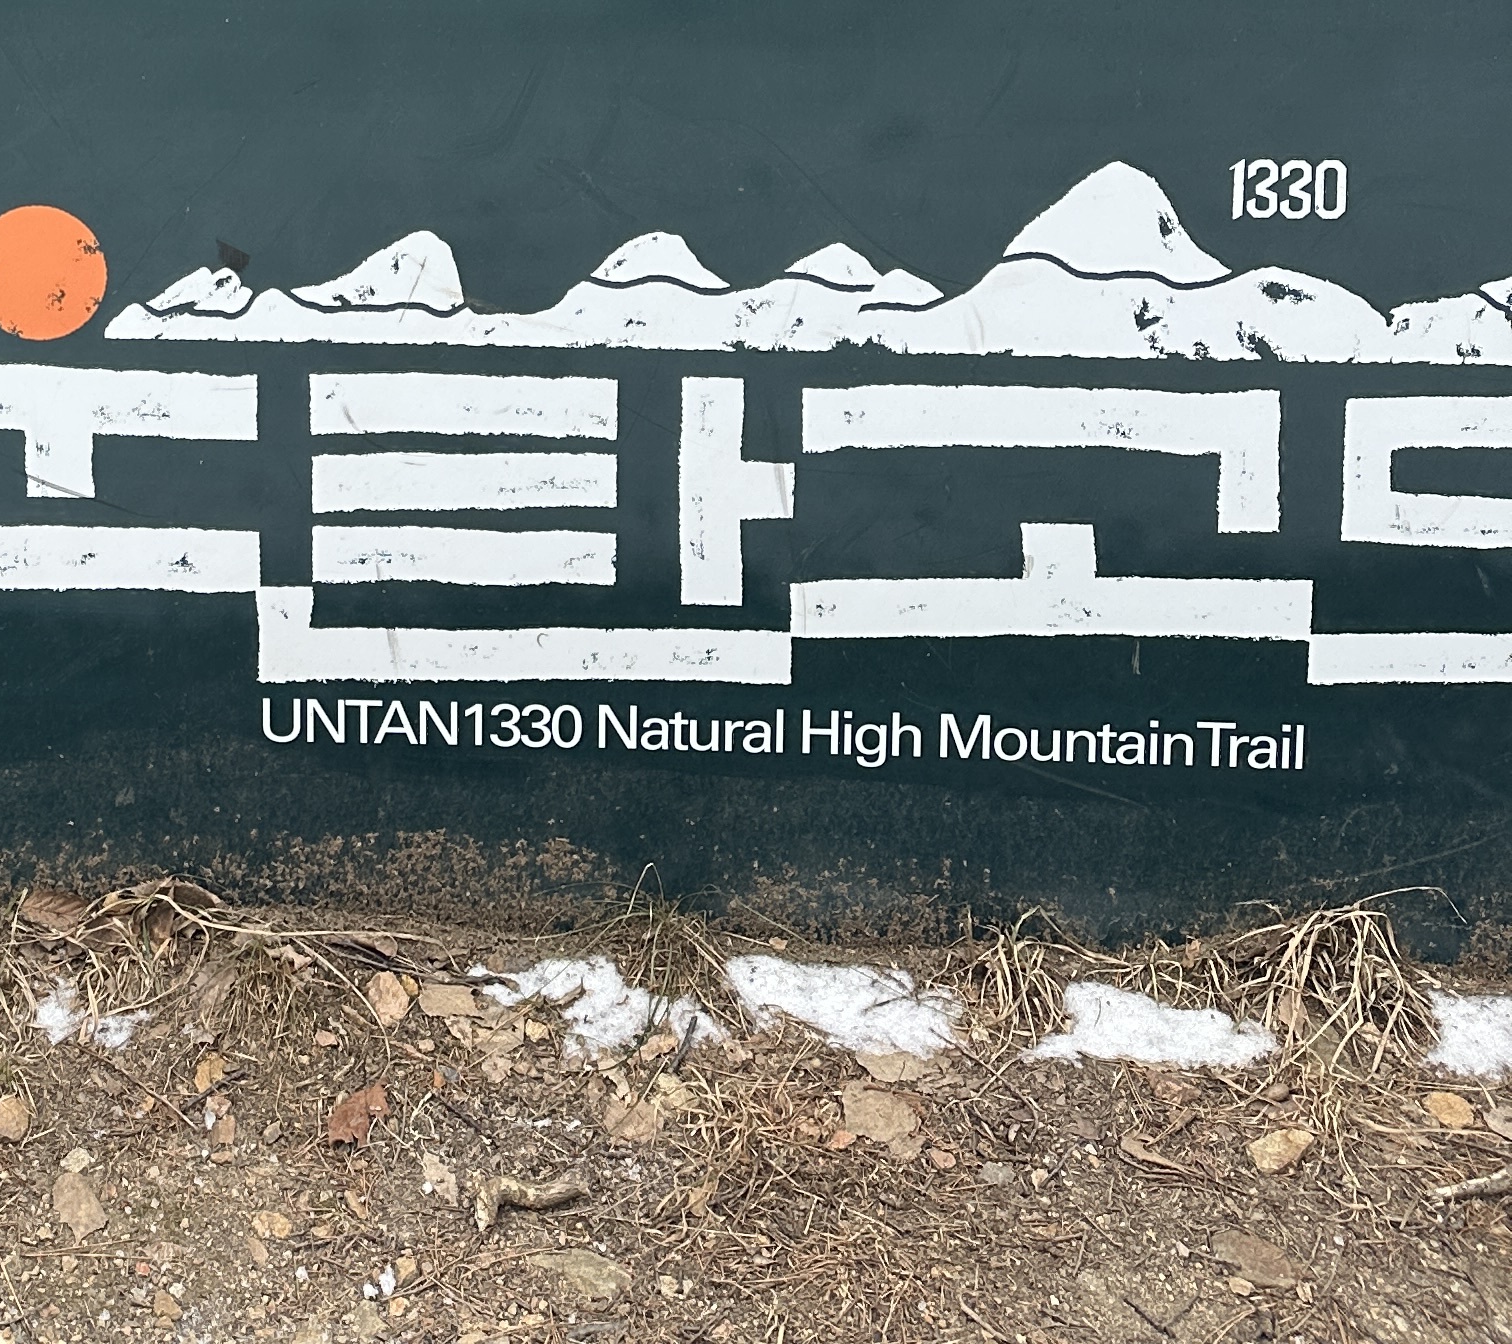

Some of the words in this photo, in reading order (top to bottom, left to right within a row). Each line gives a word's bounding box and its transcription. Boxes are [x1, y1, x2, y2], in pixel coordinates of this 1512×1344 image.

[1228, 158, 1349, 220] 1330
[262, 697, 583, 749] UNTAN1330
[598, 704, 784, 754] Natural
[801, 708, 922, 768] High
